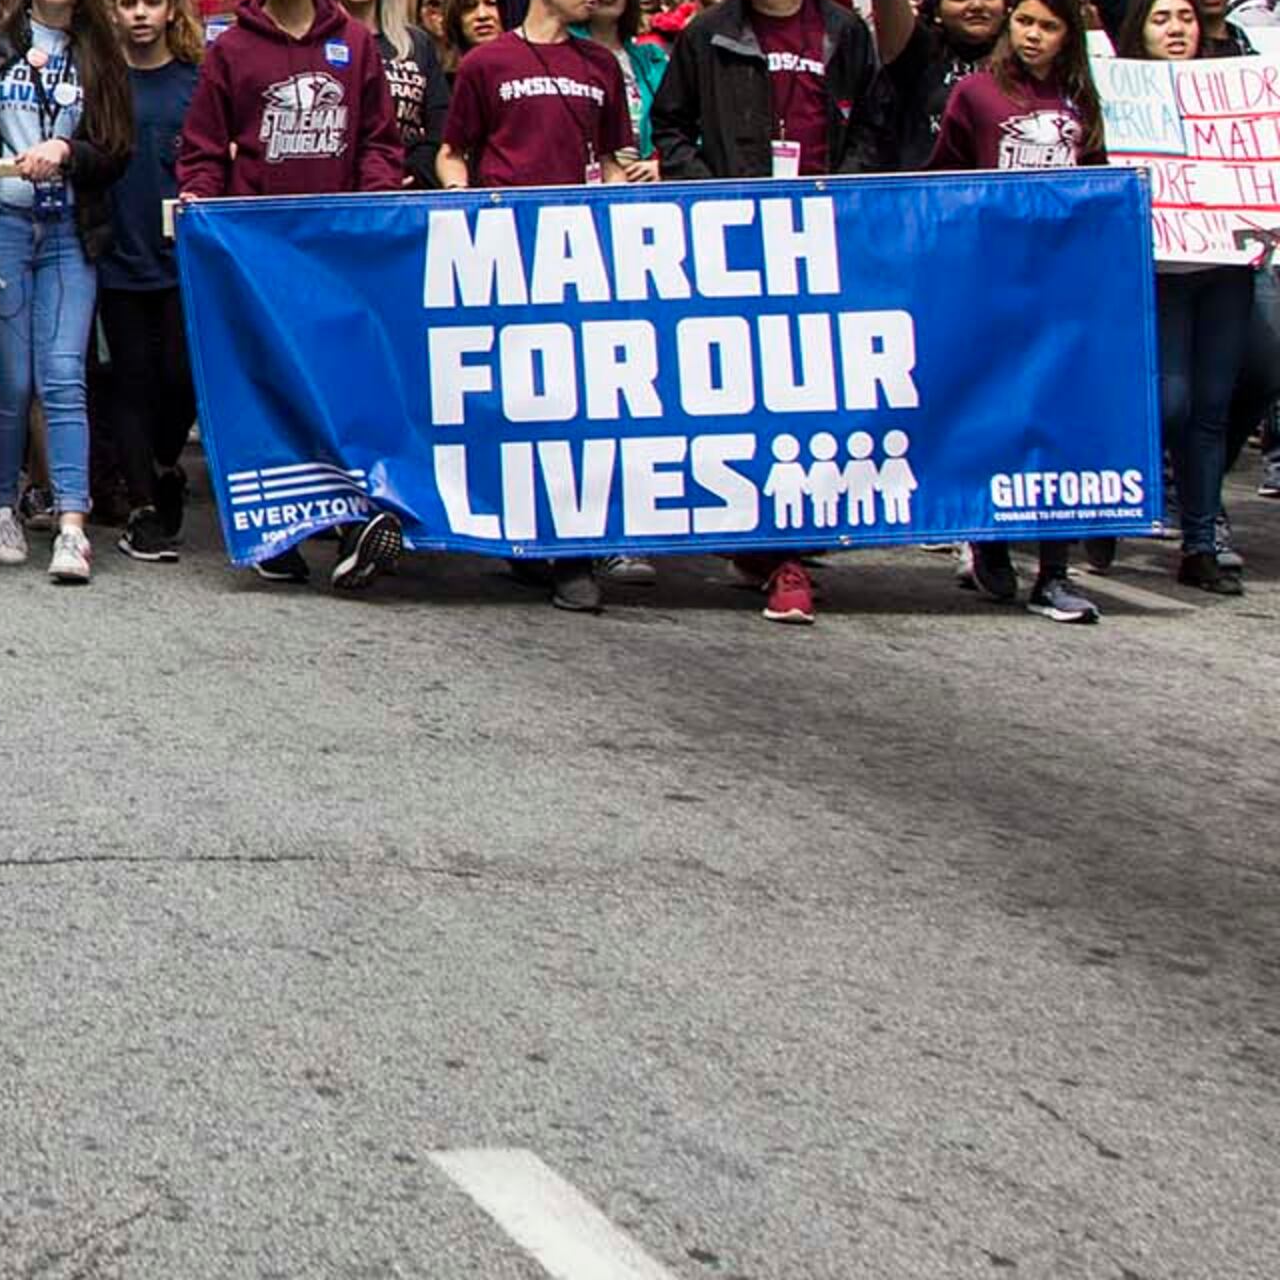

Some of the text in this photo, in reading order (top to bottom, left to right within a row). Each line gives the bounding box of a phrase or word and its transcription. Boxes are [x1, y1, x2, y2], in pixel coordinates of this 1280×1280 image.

[268, 130, 347, 161] DOUGLAS
[422, 197, 840, 308] MARCH
[427, 310, 919, 425] FOR OUR
[234, 497, 371, 531] EVERYTOW
[431, 432, 760, 541] LIVES
[990, 469, 1144, 508] GIFFORDS
